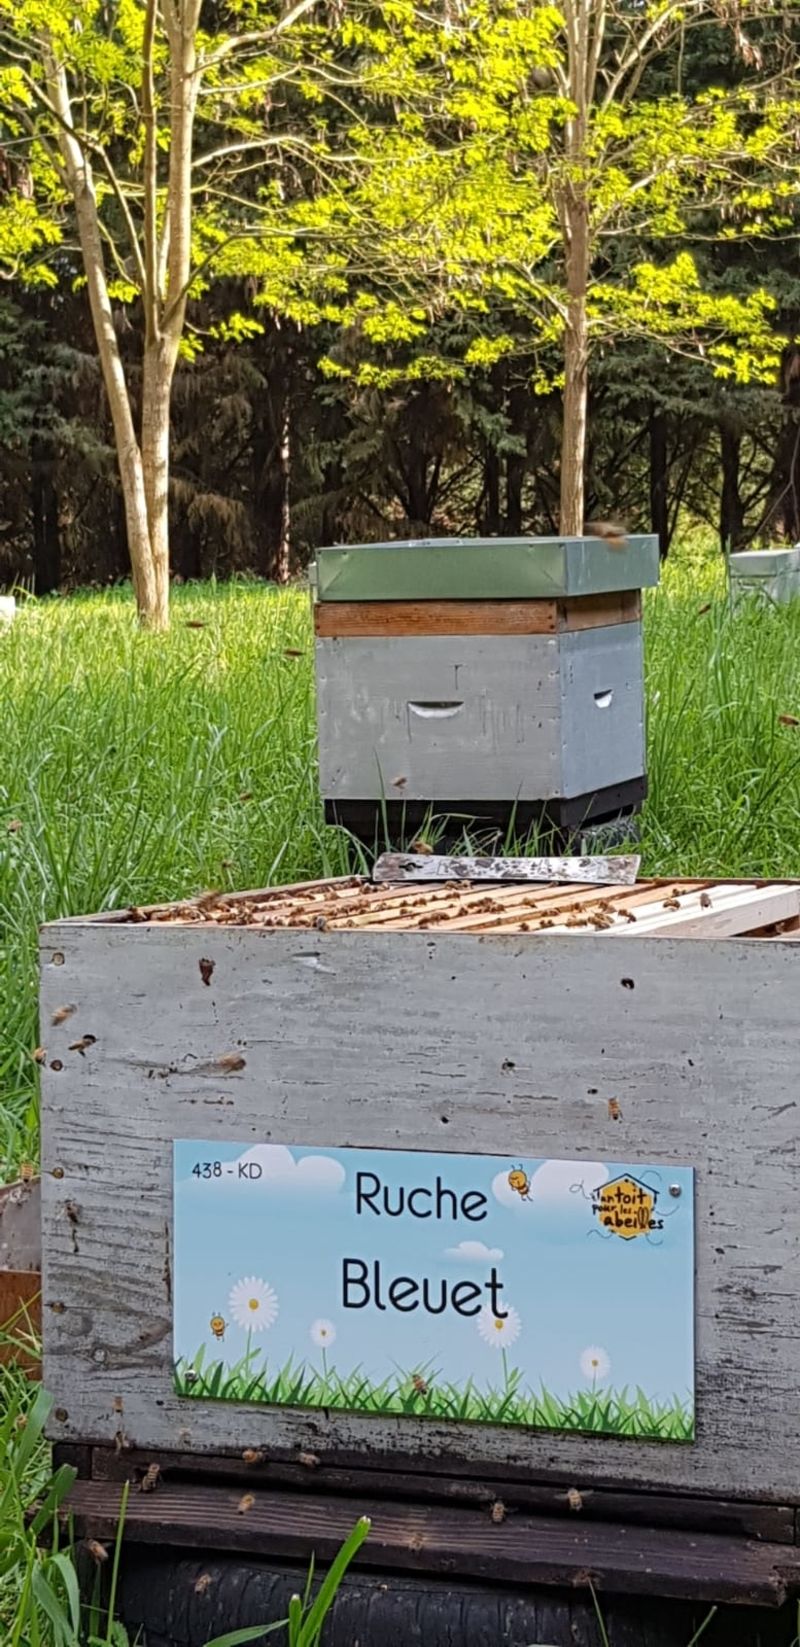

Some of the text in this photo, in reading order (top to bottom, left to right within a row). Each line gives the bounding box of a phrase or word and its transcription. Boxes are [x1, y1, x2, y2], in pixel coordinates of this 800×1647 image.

[191, 1161, 222, 1179] 438
[238, 1162, 263, 1180] KD
[356, 1171, 488, 1222] Ruche
[614, 1187, 647, 1205] toit
[592, 1204, 632, 1215] pour les
[603, 1207, 664, 1230] abeilles
[342, 1257, 509, 1320] Bleuet
